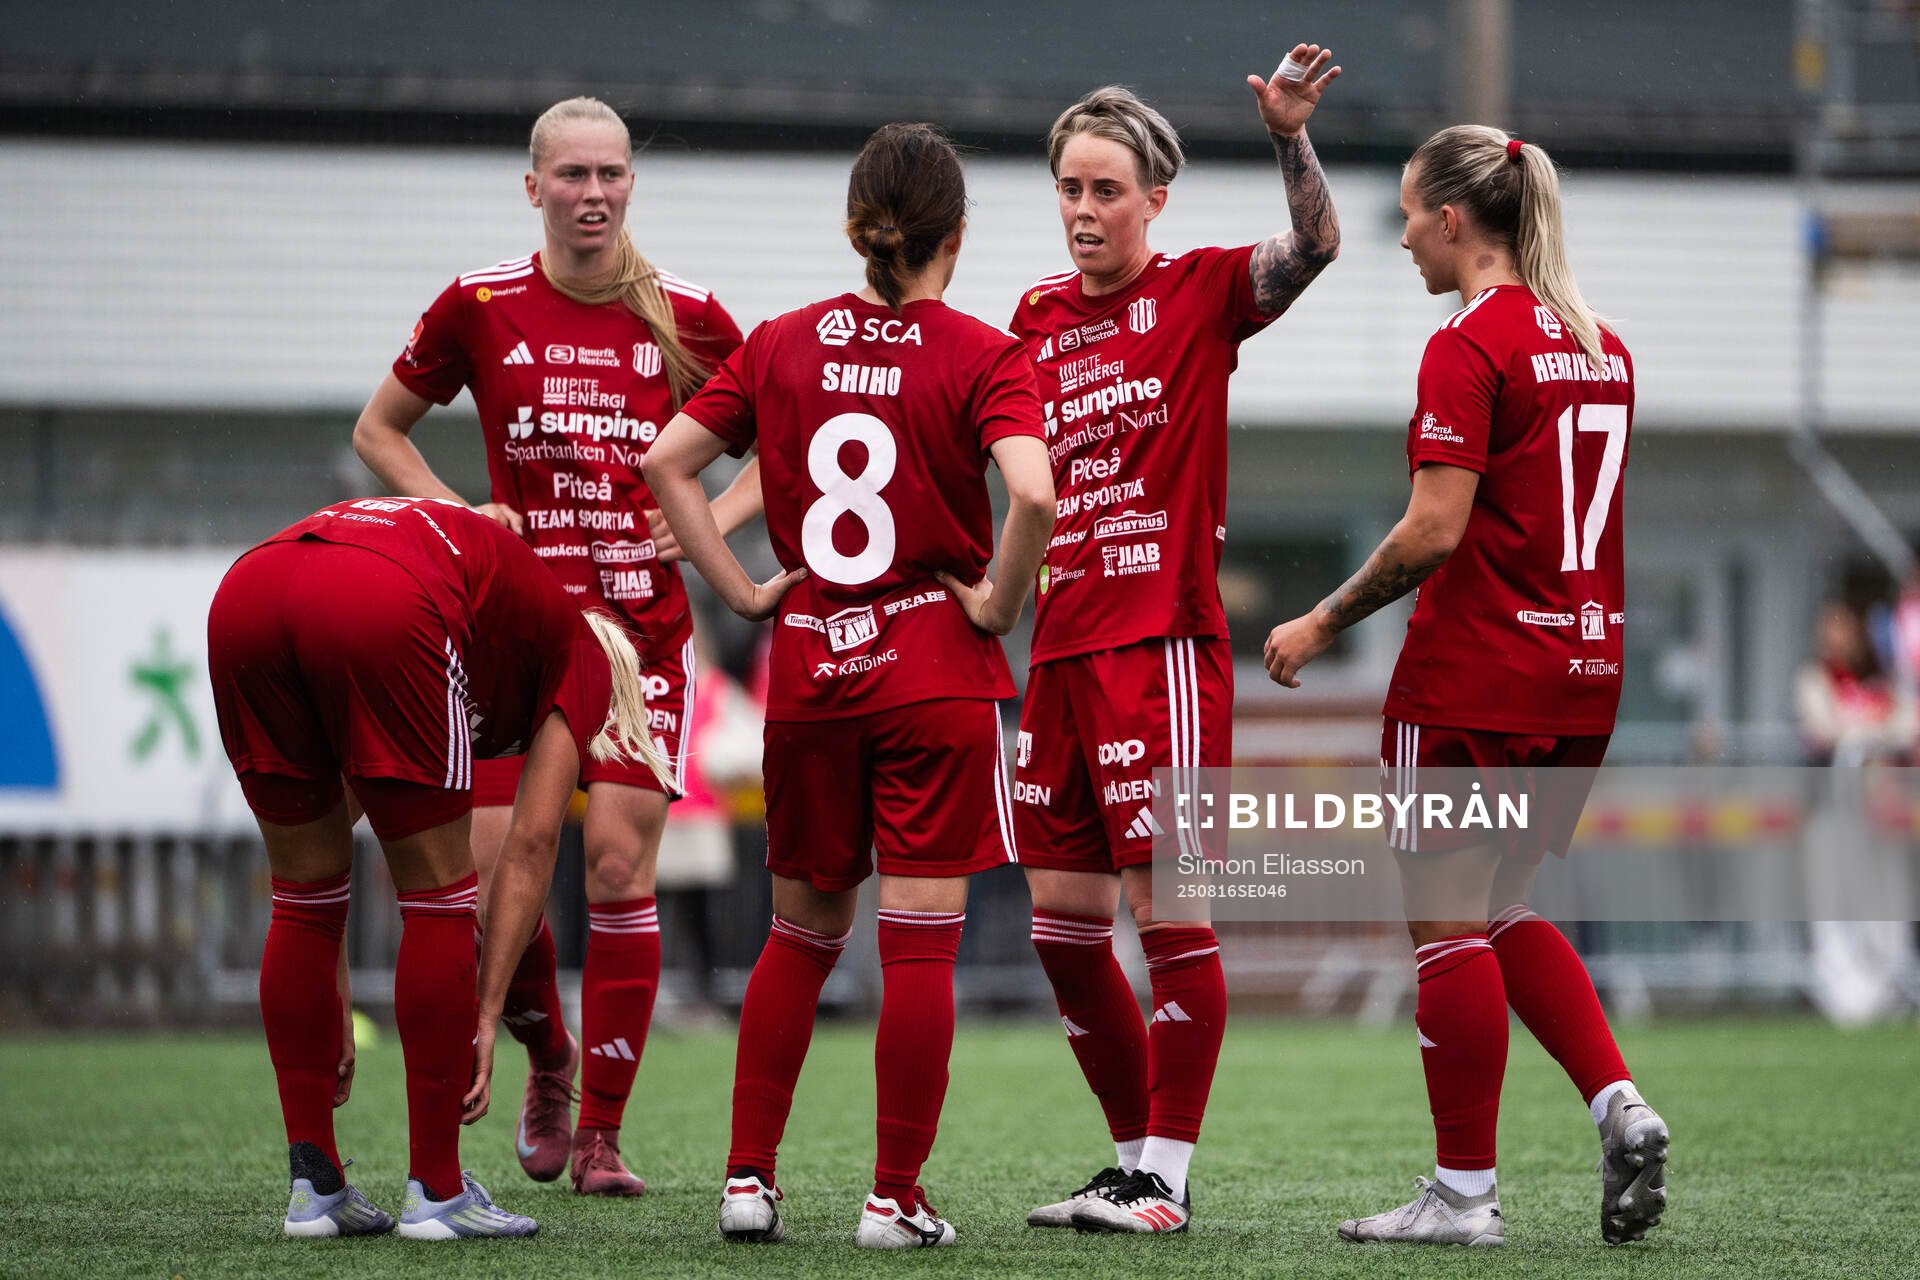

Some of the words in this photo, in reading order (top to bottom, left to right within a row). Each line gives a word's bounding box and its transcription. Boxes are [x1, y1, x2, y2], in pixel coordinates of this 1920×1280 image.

[860, 317, 923, 346] SCA
[1081, 318, 1116, 336] Smurfit
[1081, 326, 1120, 344] Westrock
[577, 346, 616, 358] Smurfit
[577, 356, 621, 368] Westrock
[1077, 354, 1102, 373] PITE
[821, 361, 902, 396] SHIHO
[1078, 359, 1125, 387] ENERGI
[1530, 352, 1629, 384] HENRIKSSON
[568, 378, 600, 393] PITE
[567, 391, 626, 409] ENERGI
[1060, 376, 1163, 425] sunpine
[540, 410, 659, 443] sunpine
[1118, 402, 1169, 433] Nord
[1438, 434, 1464, 443] GAMES
[504, 438, 605, 466] Sparbanken
[609, 442, 646, 469] Nor
[1070, 447, 1121, 487] Piteå
[553, 472, 612, 501] Piteå
[1083, 478, 1145, 513] SPORTIA
[1557, 403, 1628, 572] 17
[801, 412, 897, 586] 8
[527, 509, 575, 530] TEAM
[578, 508, 635, 531] SPORTIA
[1097, 515, 1164, 537] ÄLVSBYHUS
[534, 543, 589, 558] NDBÄCKS
[1117, 542, 1161, 567] JIAB
[612, 569, 653, 593] JIAB
[1118, 562, 1161, 576] HYRCENTER
[890, 591, 939, 614] PEAB
[1609, 613, 1624, 624] PE
[838, 648, 898, 676] KAIDING
[1584, 662, 1619, 676] KAIDING
